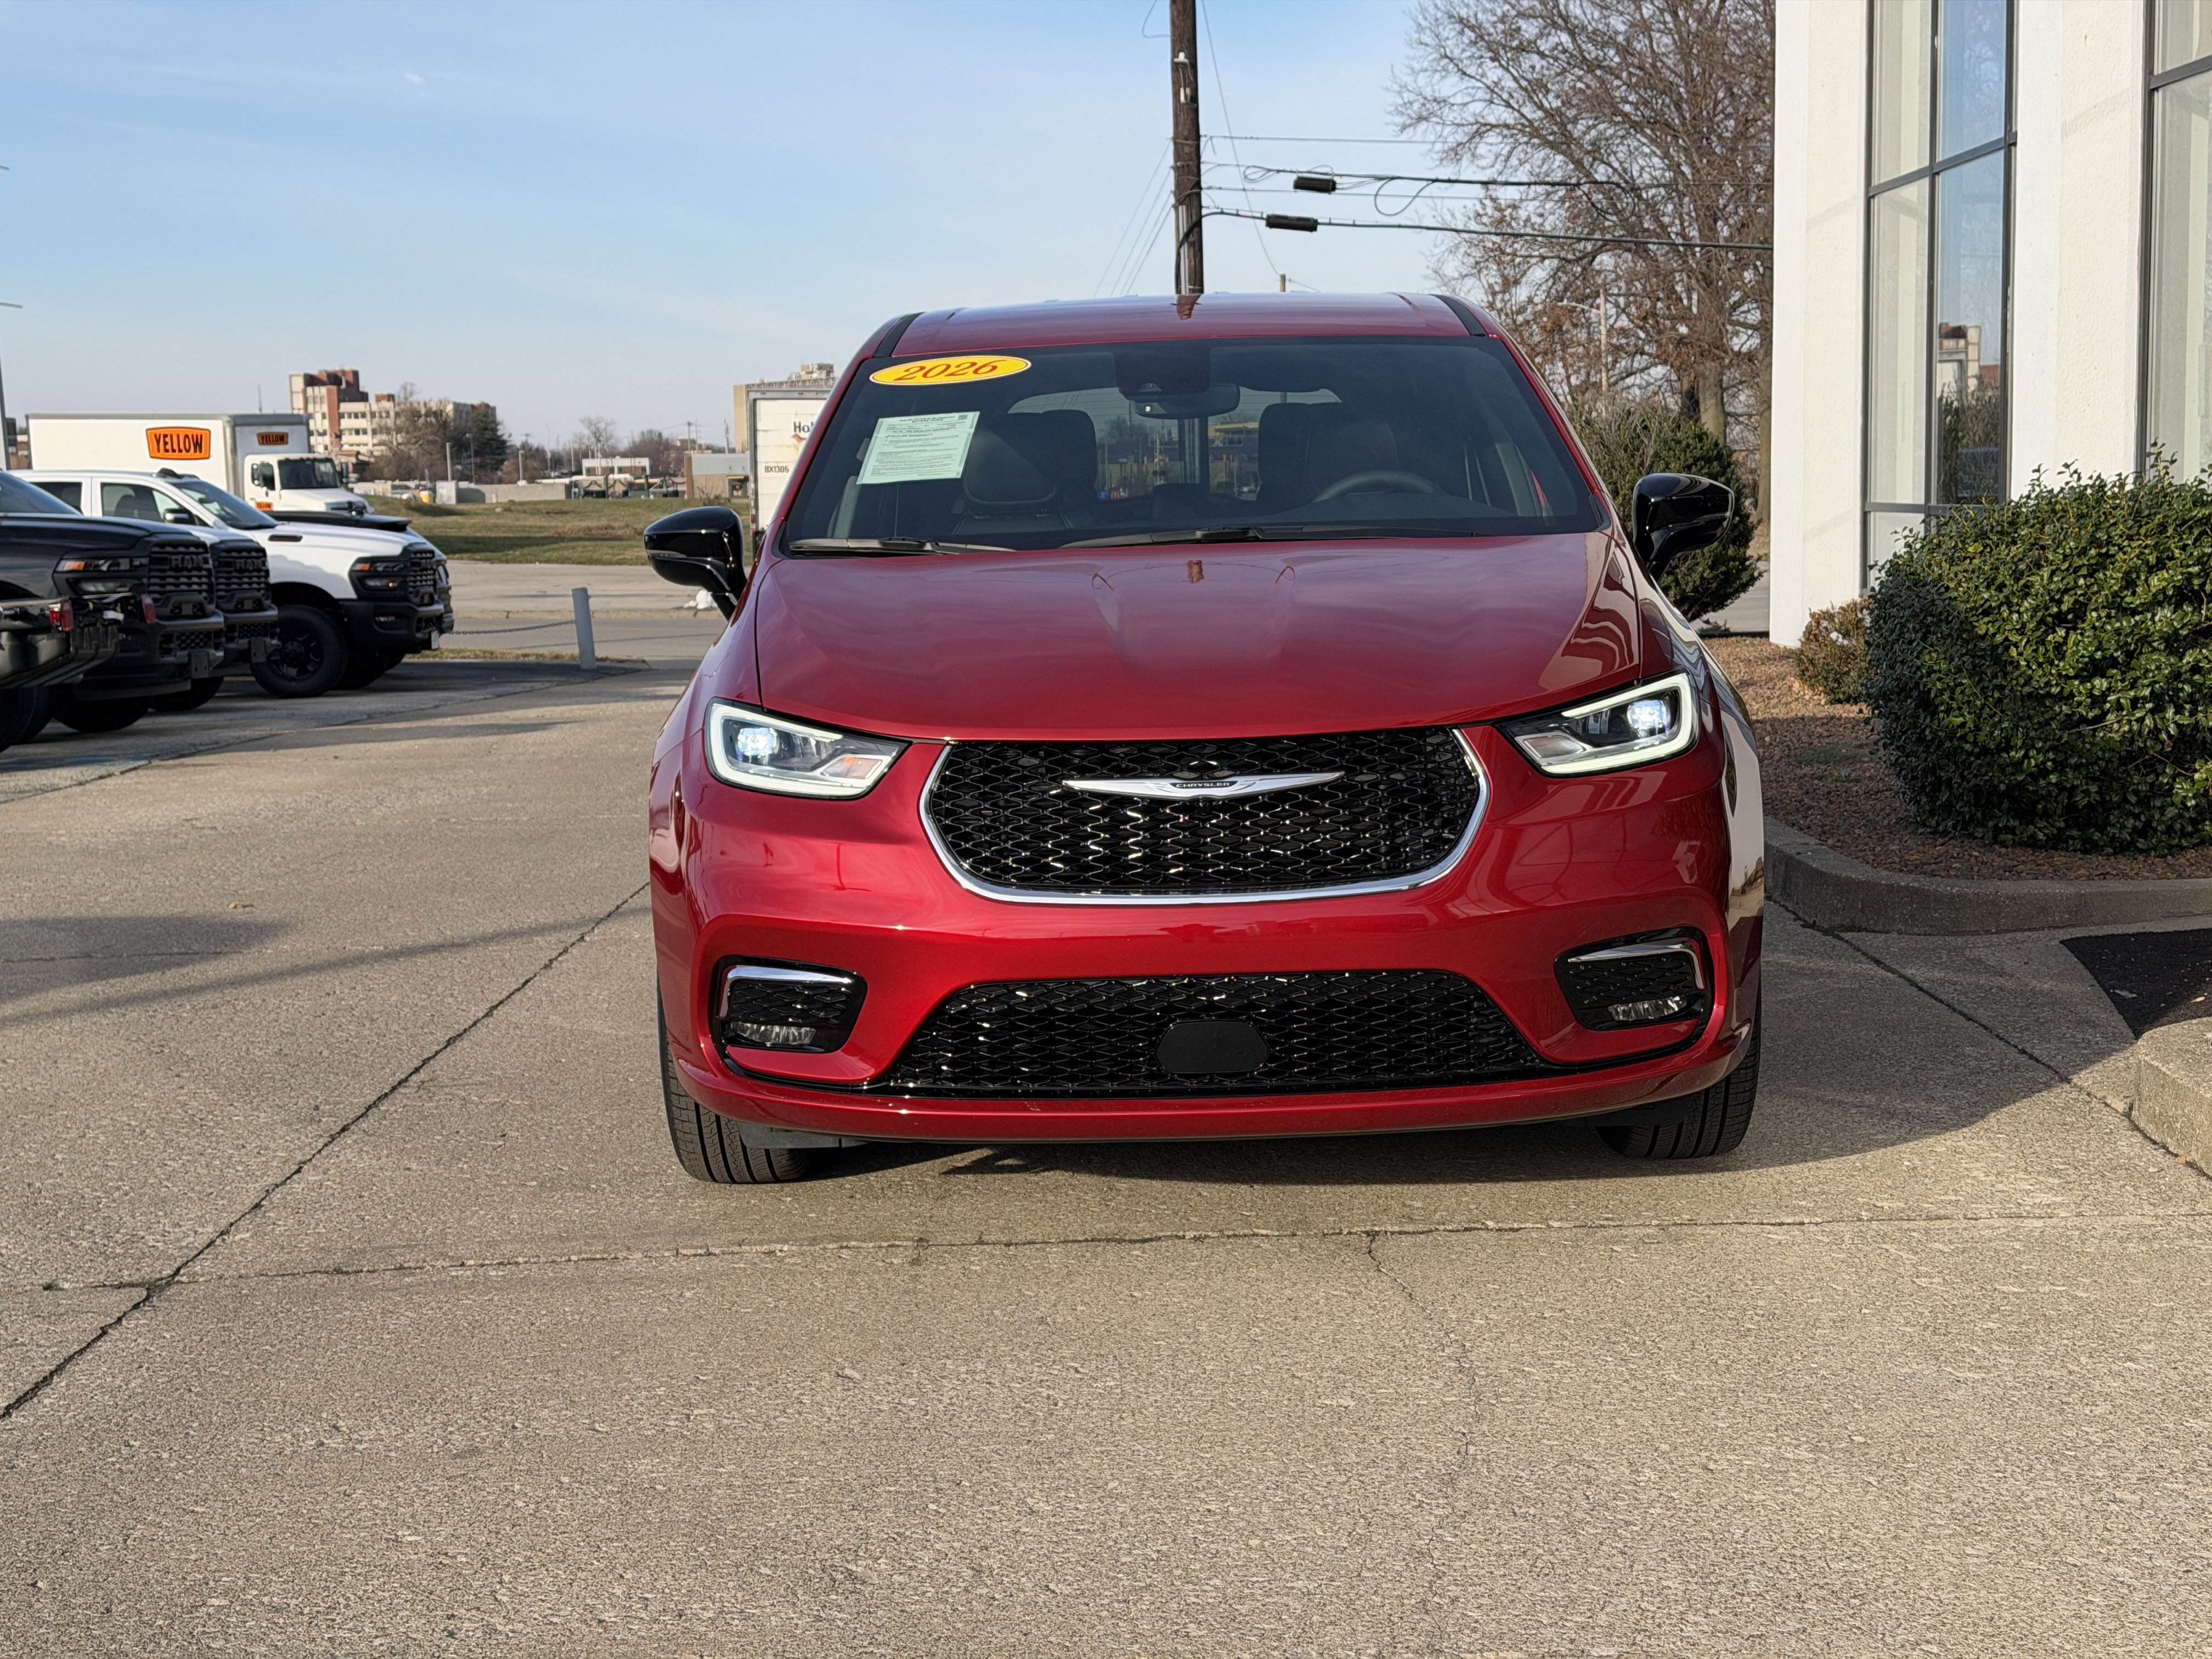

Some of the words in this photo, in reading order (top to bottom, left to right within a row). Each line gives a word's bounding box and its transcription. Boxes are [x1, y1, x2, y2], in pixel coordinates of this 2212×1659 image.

[893, 359, 1007, 381] 2026
[154, 433, 203, 454] YELLOW
[260, 434, 284, 443] YELLOW
[171, 554, 203, 568] RAM
